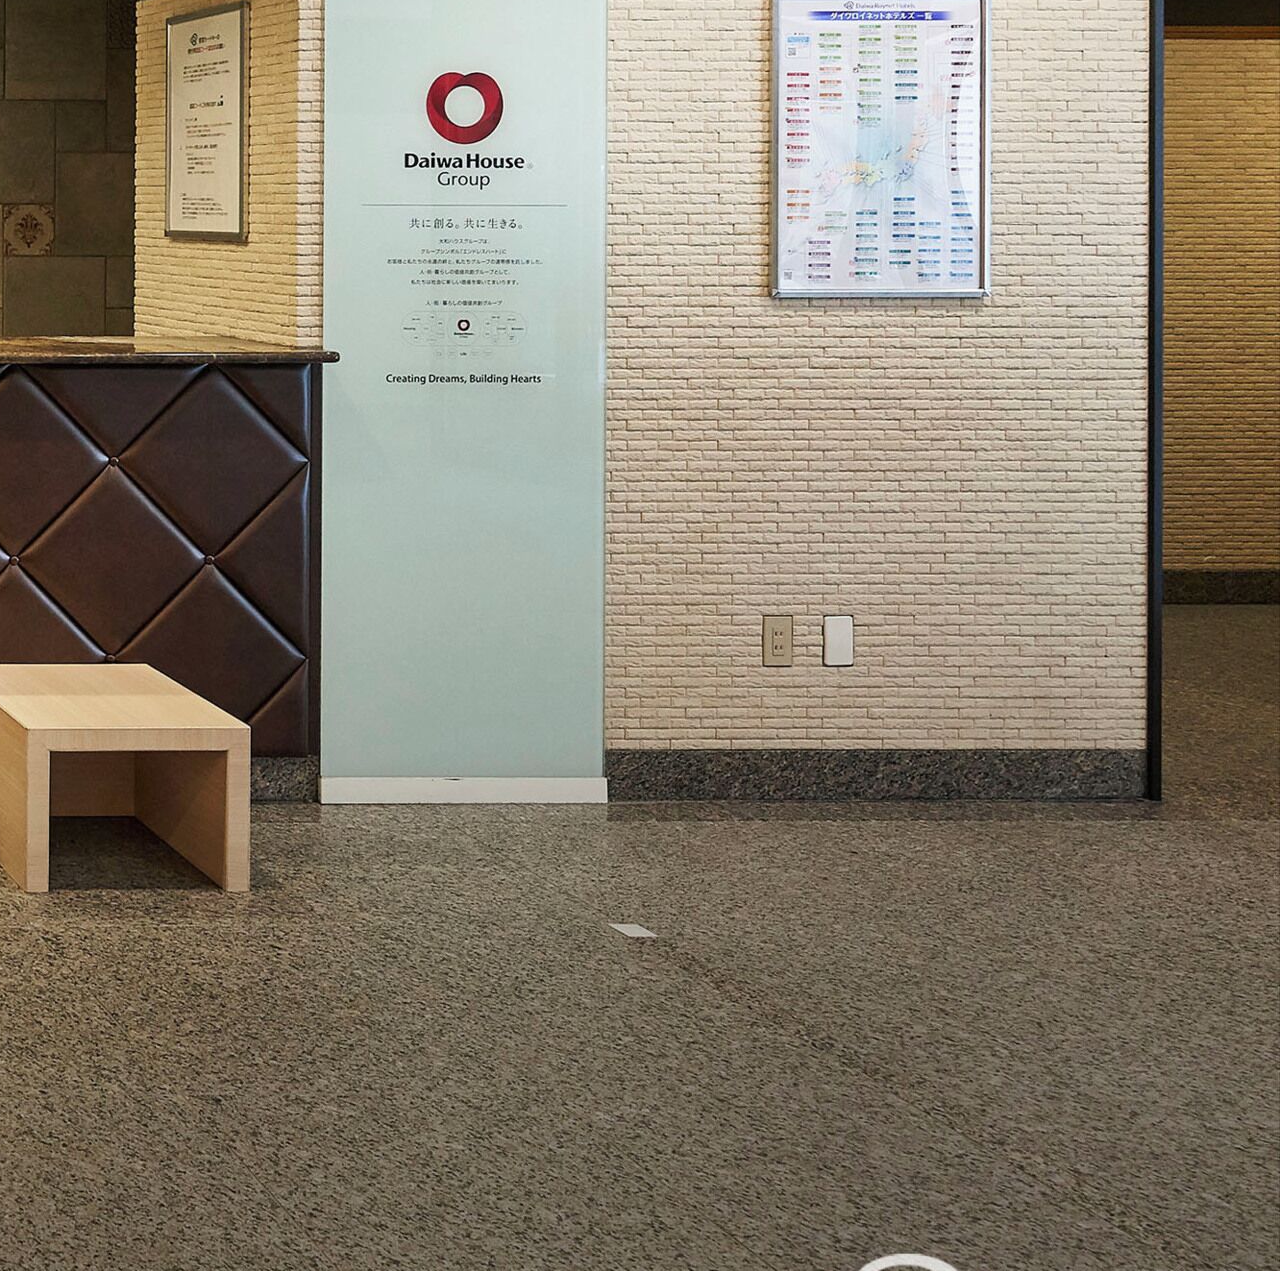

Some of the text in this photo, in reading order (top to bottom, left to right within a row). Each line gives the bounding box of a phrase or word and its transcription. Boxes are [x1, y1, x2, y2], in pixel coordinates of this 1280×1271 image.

[404, 152, 525, 169] Daiwa House
[437, 171, 491, 190] Group
[385, 373, 542, 386] Creating Dreams, Building Hearts
